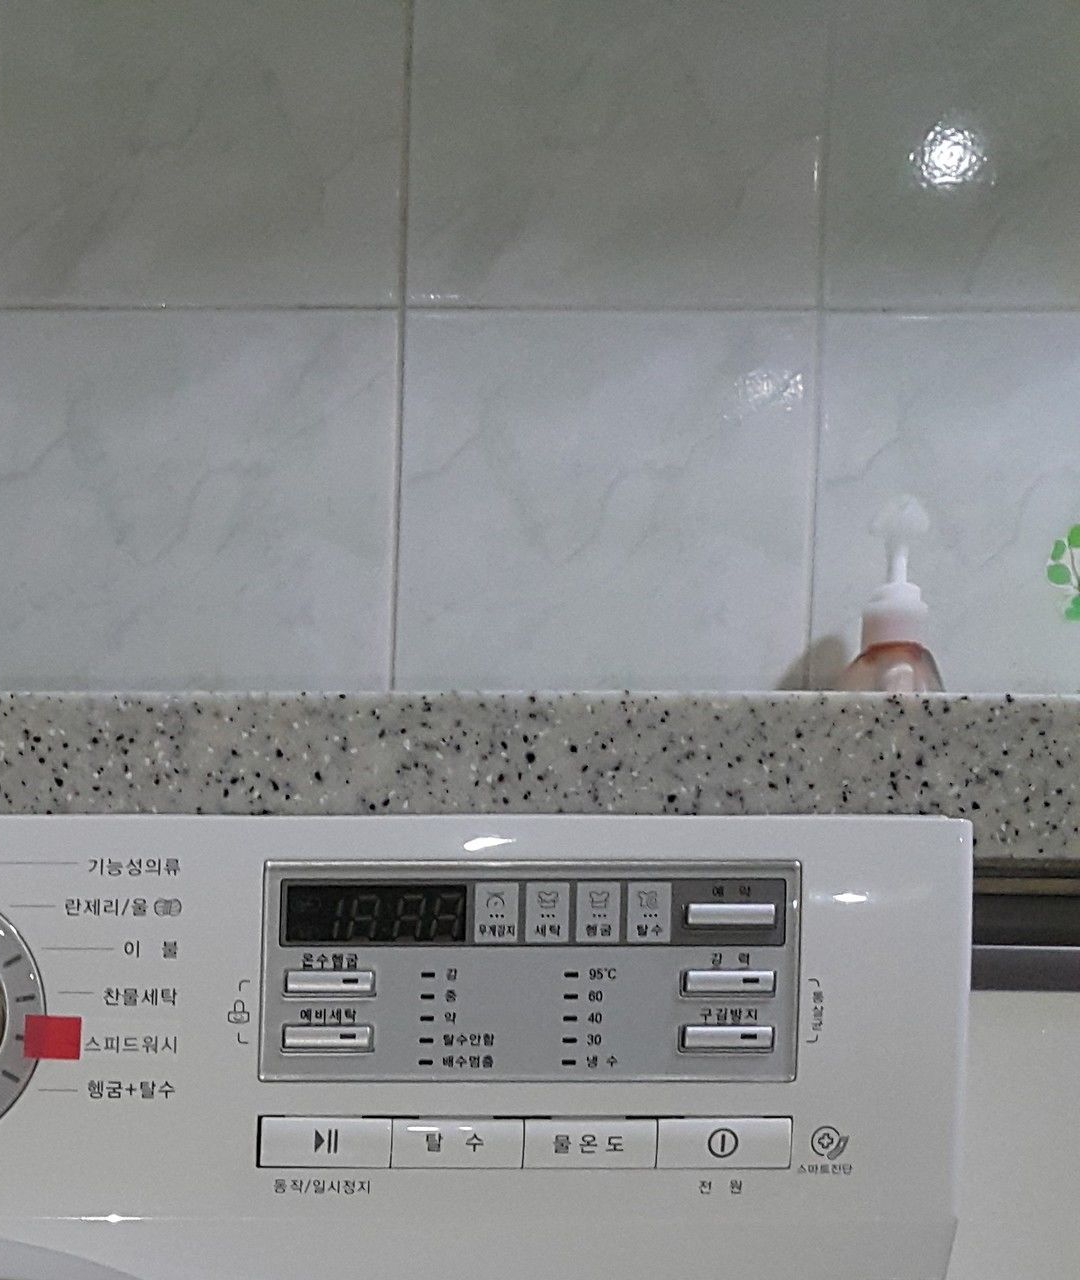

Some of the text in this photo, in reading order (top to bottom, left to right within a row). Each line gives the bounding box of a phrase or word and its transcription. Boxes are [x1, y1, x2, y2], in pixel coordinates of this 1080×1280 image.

[88, 858, 181, 876] 기능성의류
[65, 898, 148, 917] 란제리/울
[479, 924, 515, 937] 무게감지
[535, 924, 561, 937] 세탁
[586, 924, 612, 937] 헹굼
[636, 924, 663, 936] 탈수
[302, 953, 359, 969] 온수헹굼
[104, 987, 177, 1006] 찬물세탁
[588, 991, 603, 1002] 60
[300, 1008, 357, 1024] 예비세탁
[444, 1012, 456, 1024] 약
[587, 1012, 603, 1024] 40
[700, 1008, 758, 1022] 구김방지
[84, 1035, 177, 1054] 스피드워시
[443, 1033, 494, 1046] 탈수안함
[587, 1034, 602, 1045] 30
[442, 1055, 494, 1068] 배수멈춤
[88, 1080, 175, 1099] 헹굼+탈수
[797, 1163, 853, 1175] 스마트진단
